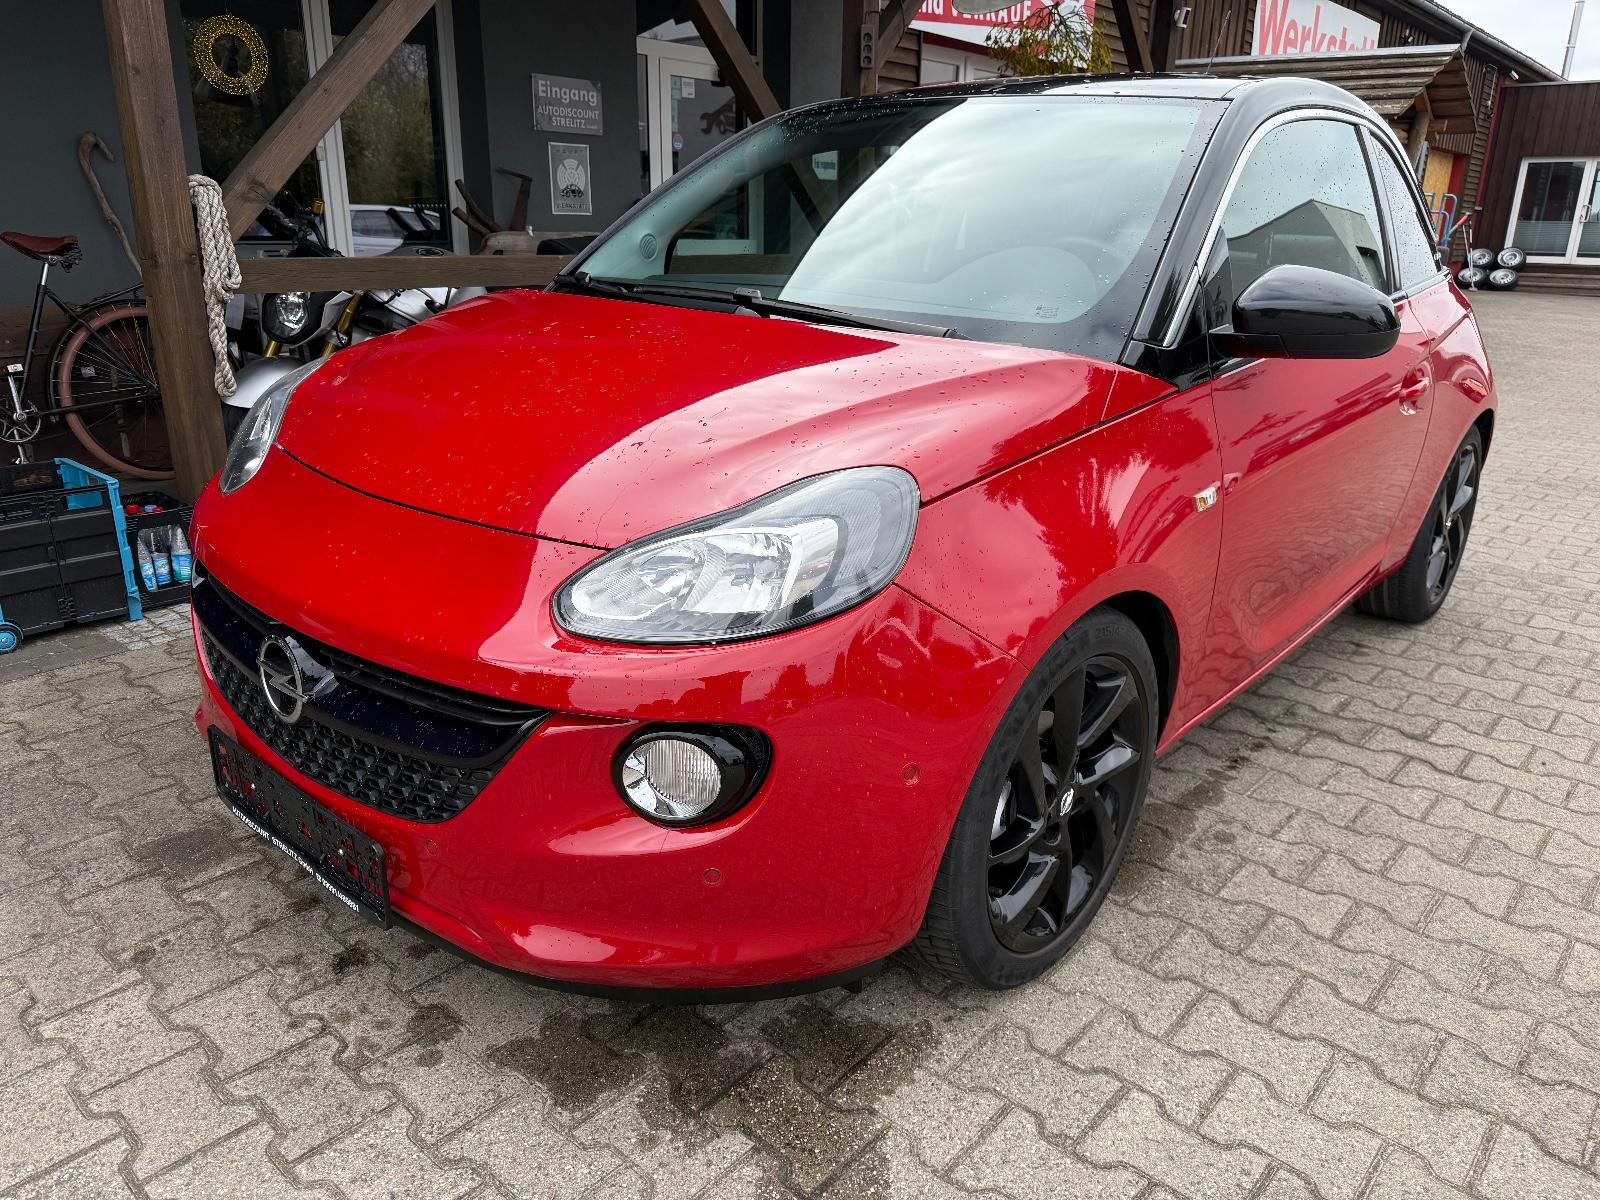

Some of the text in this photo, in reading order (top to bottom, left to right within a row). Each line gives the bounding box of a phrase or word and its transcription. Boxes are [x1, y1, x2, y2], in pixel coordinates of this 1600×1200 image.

[1257, 0, 1375, 56] Werkst
[538, 79, 597, 106] Eingang
[537, 105, 599, 120] AUTODISCOUNT
[552, 117, 586, 129] STRELITZ
